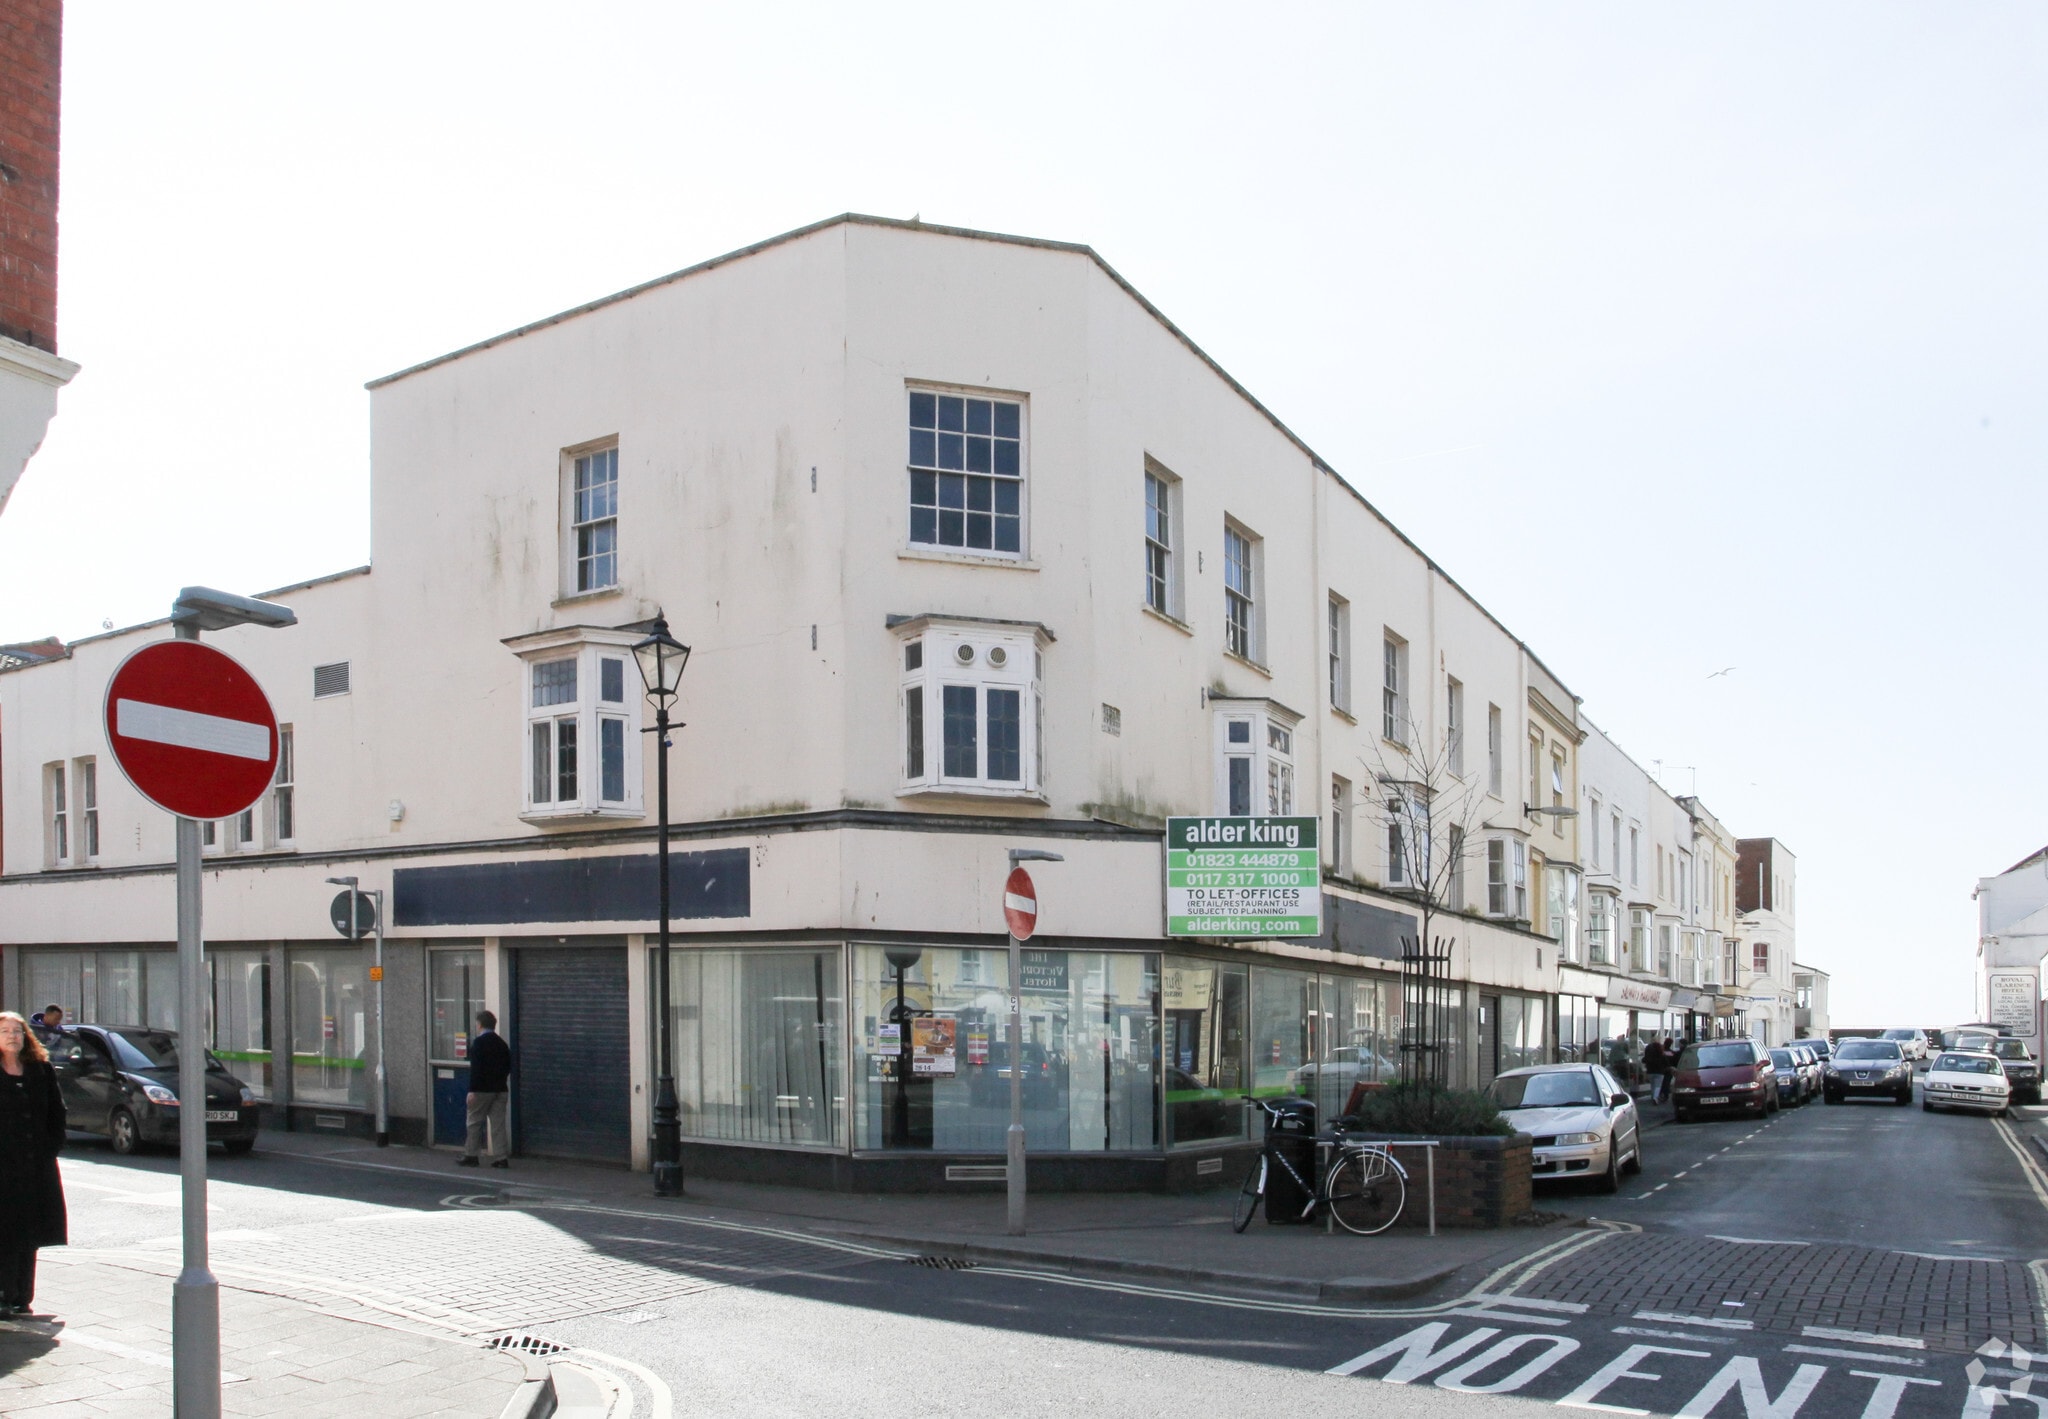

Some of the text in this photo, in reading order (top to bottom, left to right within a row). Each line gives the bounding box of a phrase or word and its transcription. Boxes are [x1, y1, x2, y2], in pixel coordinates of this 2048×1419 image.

[1186, 819, 1299, 848] alder king
[1186, 853, 1299, 867] 01823 444879
[1186, 873, 1300, 886] 0117 317 1000
[1187, 889, 1206, 900] TO
[1187, 907, 1287, 915] SUBJECT TO PLANNING)
[1187, 917, 1300, 934] alderking.com
[1324, 1321, 1581, 1394] NO
